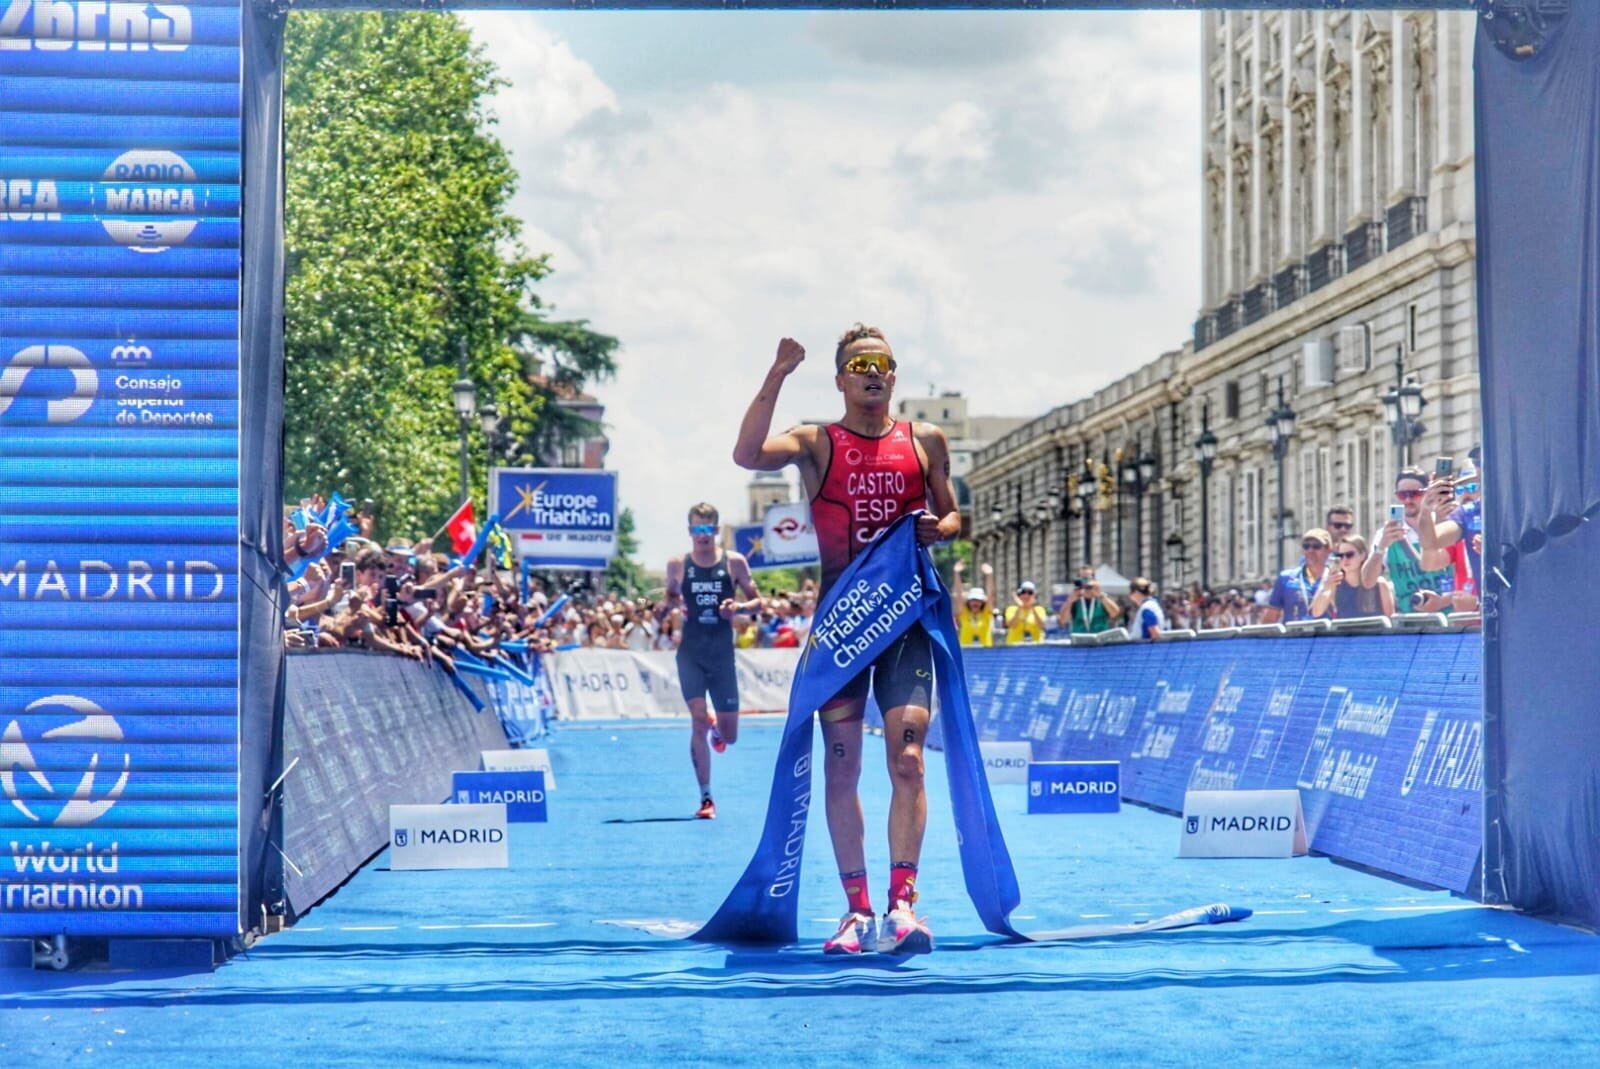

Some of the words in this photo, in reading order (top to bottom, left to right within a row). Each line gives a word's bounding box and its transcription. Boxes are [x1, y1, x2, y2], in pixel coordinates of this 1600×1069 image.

[115, 164, 184, 180] RADIO
[0, 178, 62, 221] CA
[105, 188, 196, 211] MARCA
[115, 375, 182, 392] Consejo
[115, 409, 137, 424] de
[141, 409, 214, 424] Deportes
[847, 471, 905, 495] CASTRO
[532, 491, 598, 509] Europe
[531, 508, 610, 526] Triathlon
[855, 499, 897, 521] ESP
[0, 560, 224, 600] MADRID
[695, 594, 719, 606] GBR
[816, 579, 871, 638] Europe
[818, 582, 894, 650] Triathlon
[904, 729, 914, 743] 6
[479, 790, 544, 803] MADRID
[1051, 781, 1117, 794] MADRID
[1211, 816, 1291, 831] MADRID
[421, 828, 503, 844] MADRID
[769, 792, 811, 897] MADRID
[9, 841, 118, 873] World
[0, 878, 143, 908] riathlon
